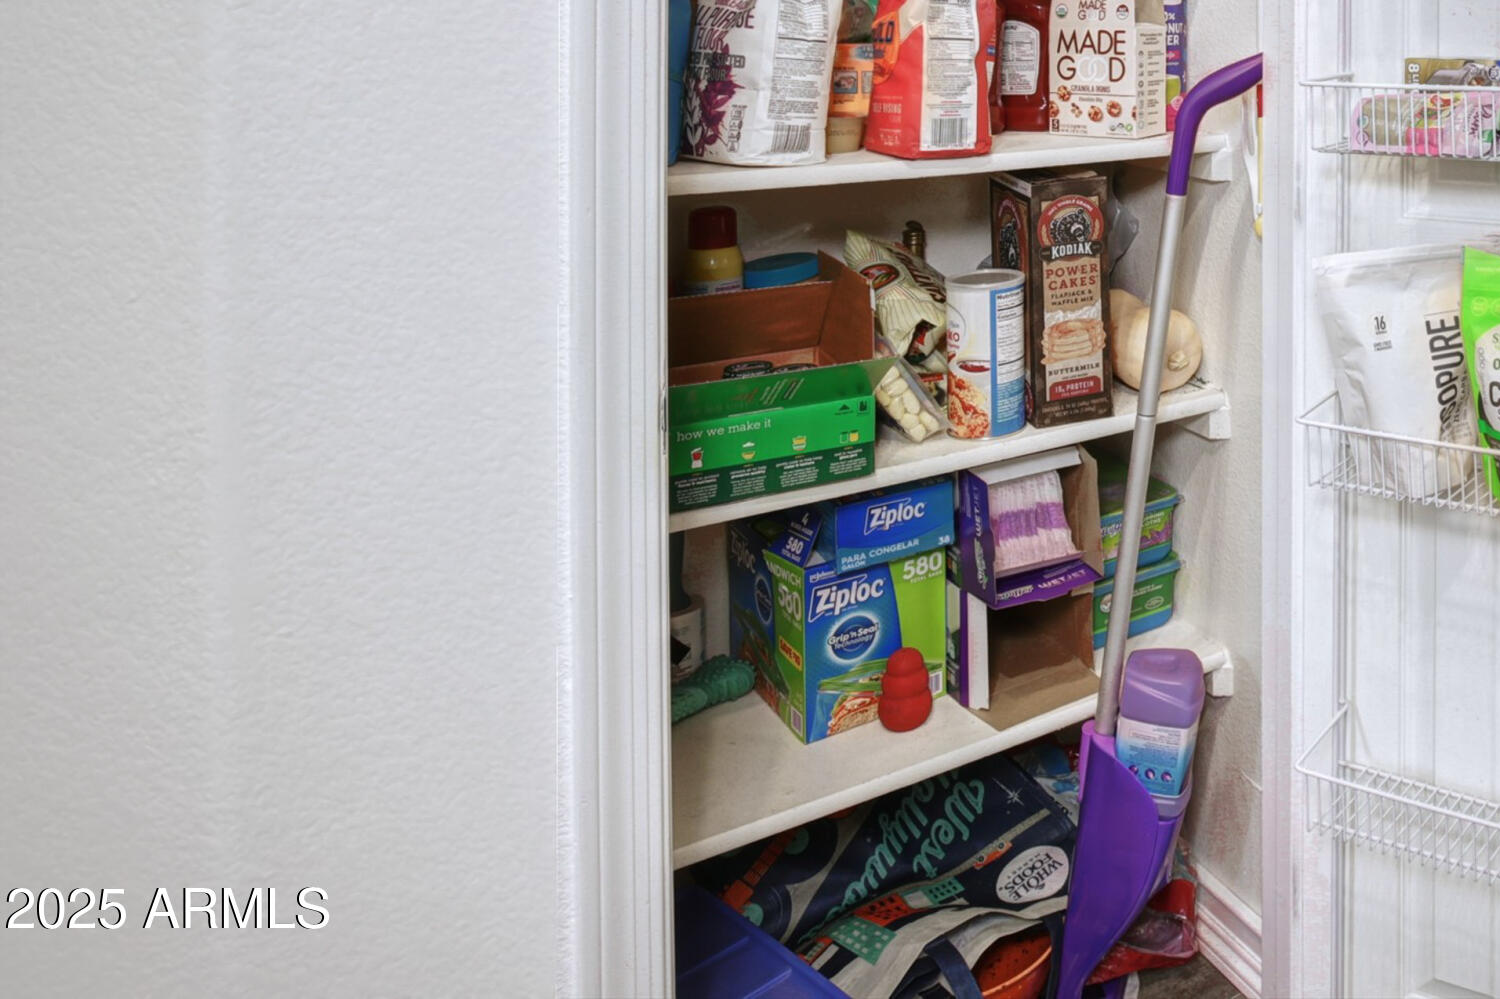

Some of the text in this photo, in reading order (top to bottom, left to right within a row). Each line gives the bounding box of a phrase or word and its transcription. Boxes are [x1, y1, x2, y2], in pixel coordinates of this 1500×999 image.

[1078, 0, 1107, 10] MADE
[1057, 30, 1126, 55] MADE
[1057, 55, 1126, 83] GOOD
[1051, 241, 1093, 260] KODIAK
[1045, 263, 1099, 280] POWER
[1048, 276, 1097, 291] CAKES
[1051, 290, 1084, 300] FLAPJACK
[1374, 315, 1387, 331] 16
[1048, 362, 1101, 377] BUTTERMILK
[1066, 380, 1095, 391] PROTEIN
[676, 418, 772, 443] how we make it
[868, 502, 926, 530] Ziploc
[841, 538, 919, 566] PARA CONGELAR
[902, 552, 942, 580] 580
[813, 578, 885, 616] Ziploc
[1004, 853, 1052, 893] FOODS
[1009, 859, 1064, 904] WHOLE
